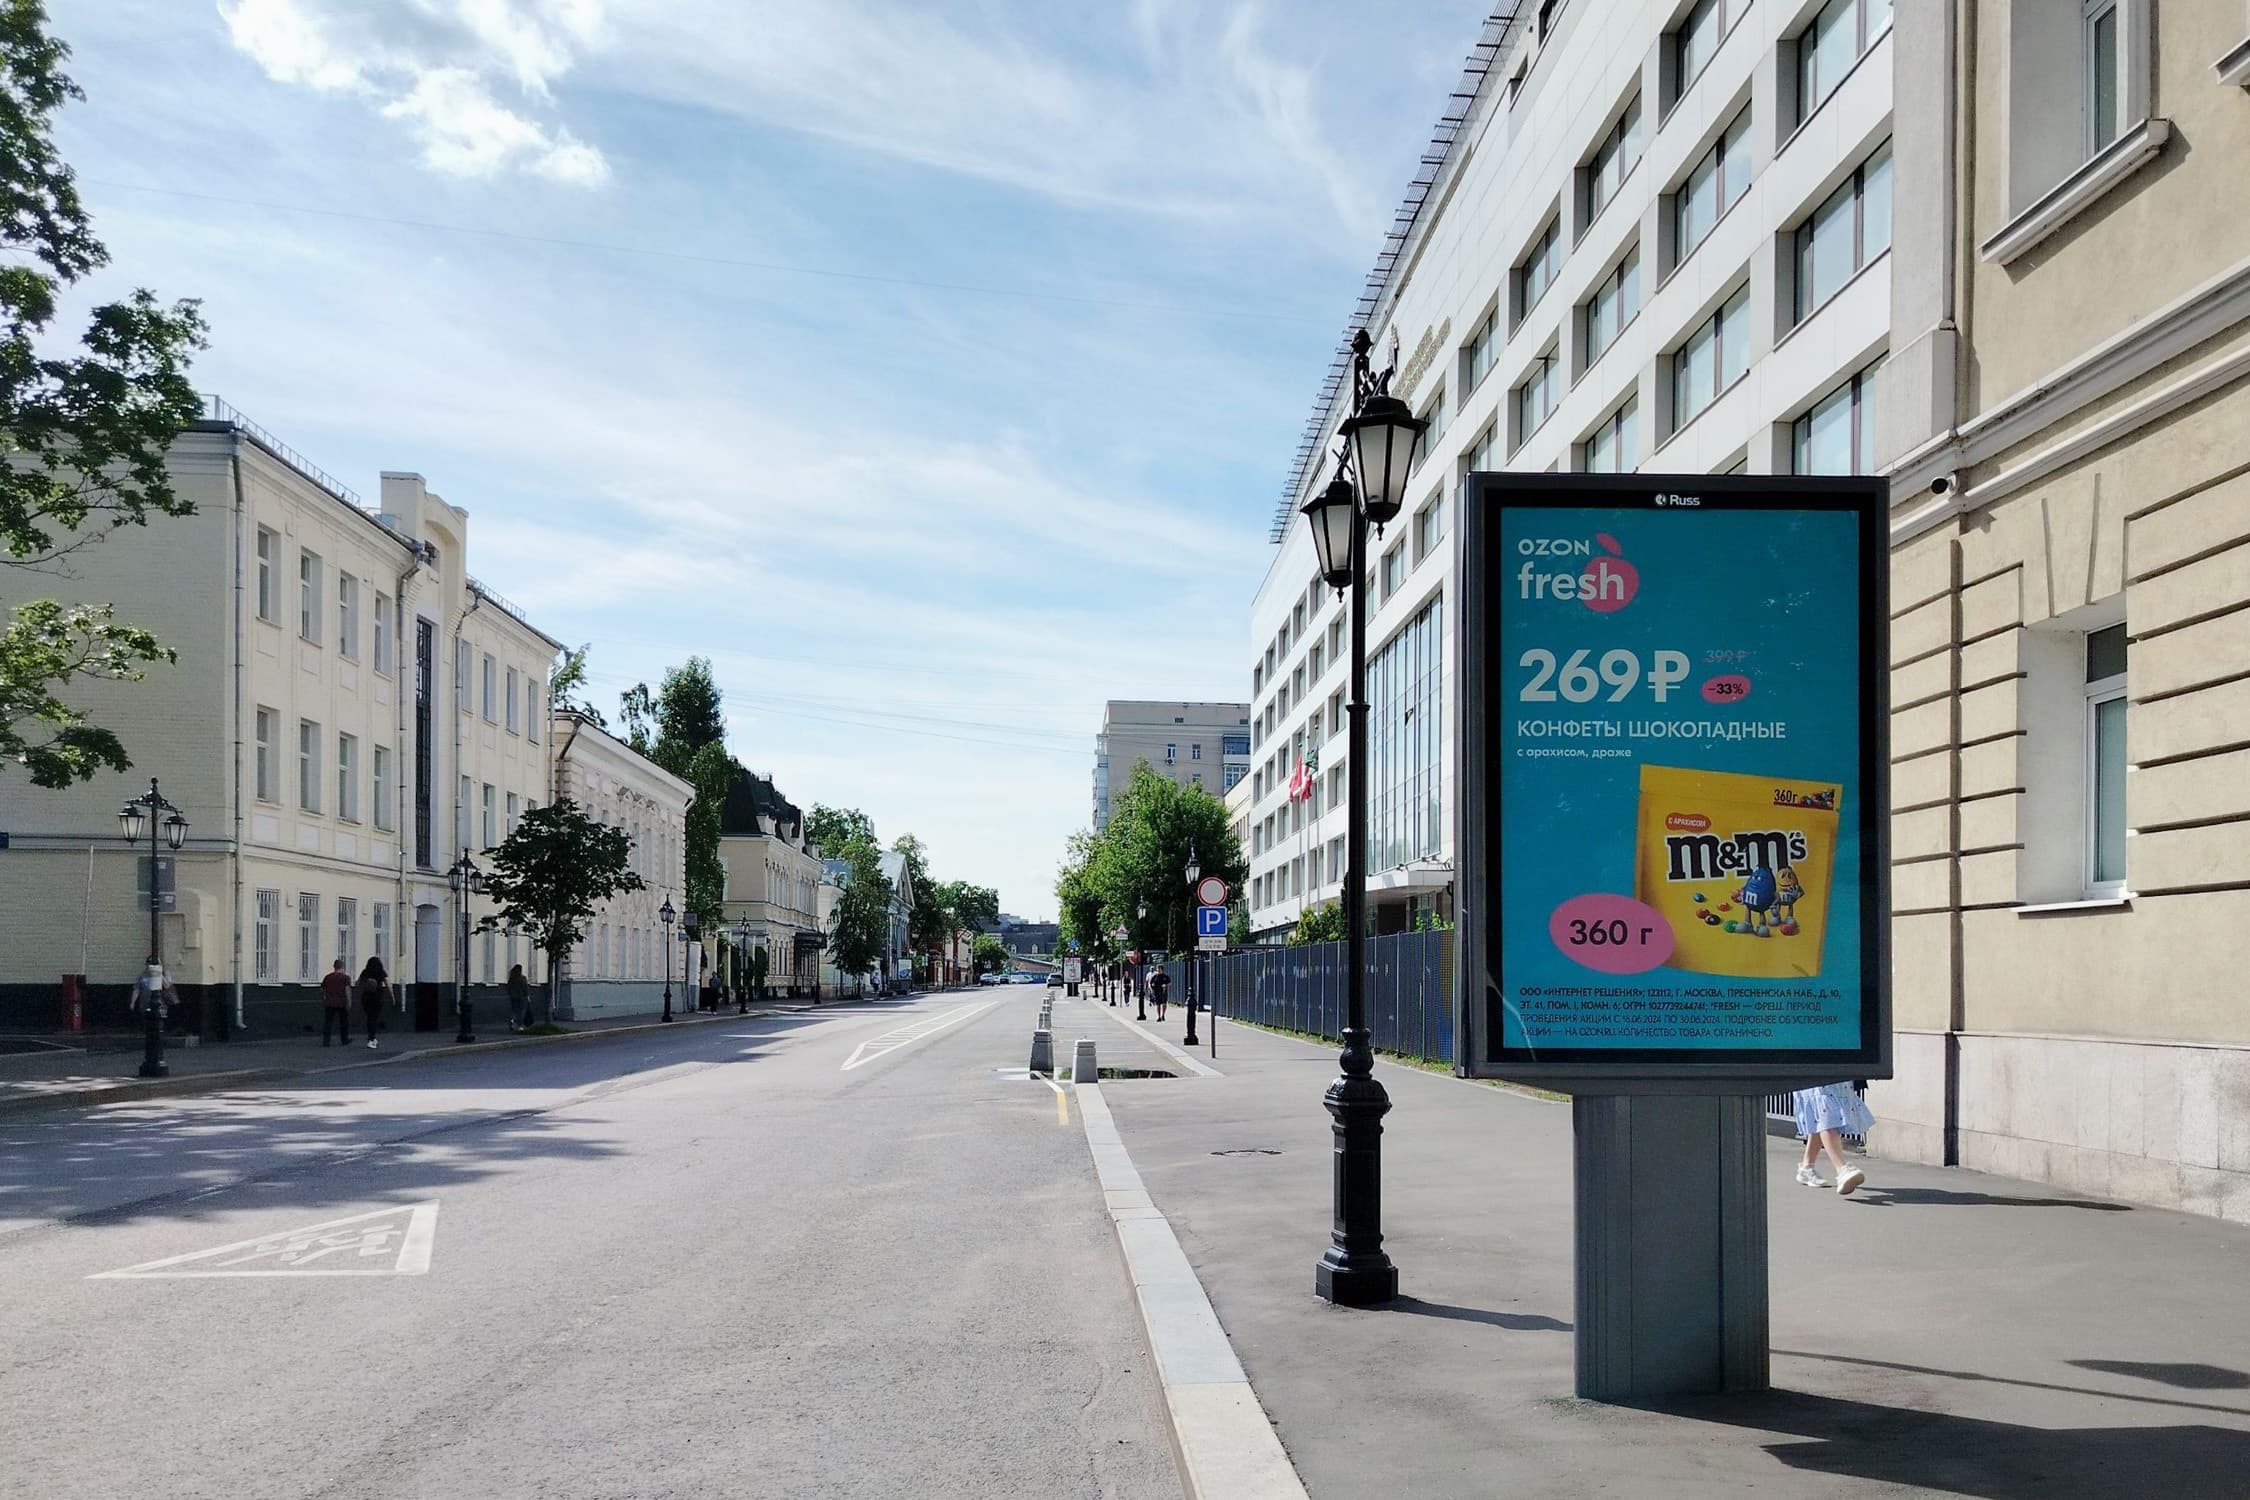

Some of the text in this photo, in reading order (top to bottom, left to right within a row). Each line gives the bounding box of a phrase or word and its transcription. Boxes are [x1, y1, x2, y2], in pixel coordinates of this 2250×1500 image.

[1670, 494, 1700, 506] Russ
[1517, 560, 1625, 600] fresh
[1517, 720, 1786, 741] КОНФЕТЫ ШОКОЛАДНЫЕ
[1517, 748, 1632, 760] с арахисом, драже
[1206, 910, 1222, 933] P
[1569, 919, 1653, 946] 360 г
[1520, 987, 1541, 996] ООО
[1544, 987, 1592, 996] «ИНТЕРНЕТ
[1727, 989, 1791, 998] ПРЕСНЕНСКАЯ
[1623, 1001, 1646, 1010] ОГРН
[1786, 1002, 1822, 1012] ПЕРИОД
[1520, 1014, 1577, 1024] ПРОВЕДЕНИЯ
[1664, 1015, 1678, 1024] ПО
[1725, 1015, 1776, 1025] ПОДРОБНЕЕ
[1779, 1015, 1790, 1024] ОБ
[1565, 1028, 1579, 1037] НА
[1619, 1028, 1676, 1037] КОЛИЧЕСТВО
[1679, 1028, 1711, 1037] ТОВАРА
